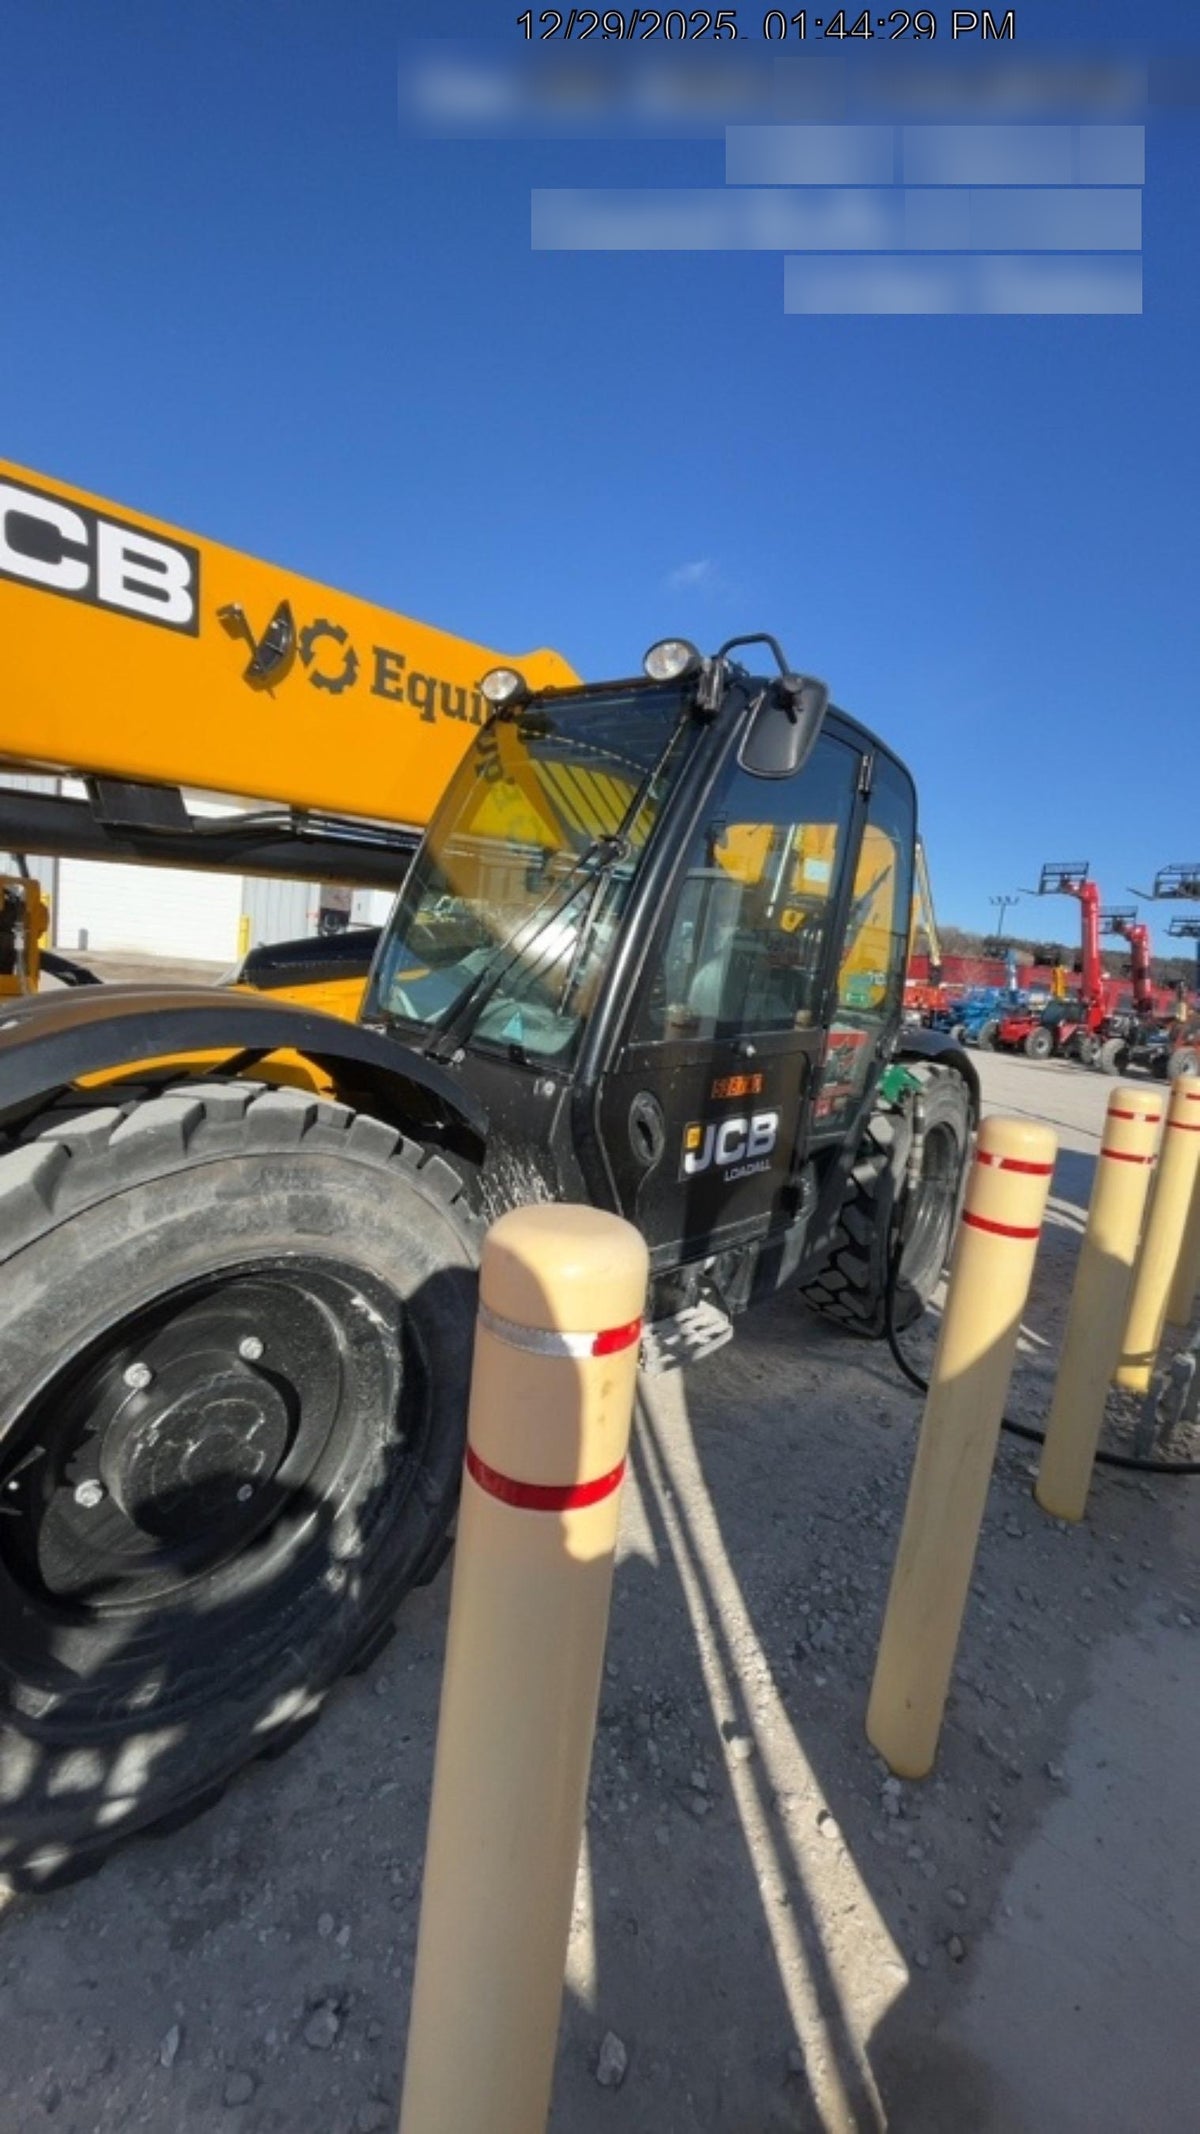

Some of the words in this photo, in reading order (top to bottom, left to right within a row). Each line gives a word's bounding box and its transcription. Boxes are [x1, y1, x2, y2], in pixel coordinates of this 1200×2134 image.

[371, 645, 492, 726] Equi
[684, 1112, 779, 1175] JCB
[723, 1159, 772, 1182] LOADALL
